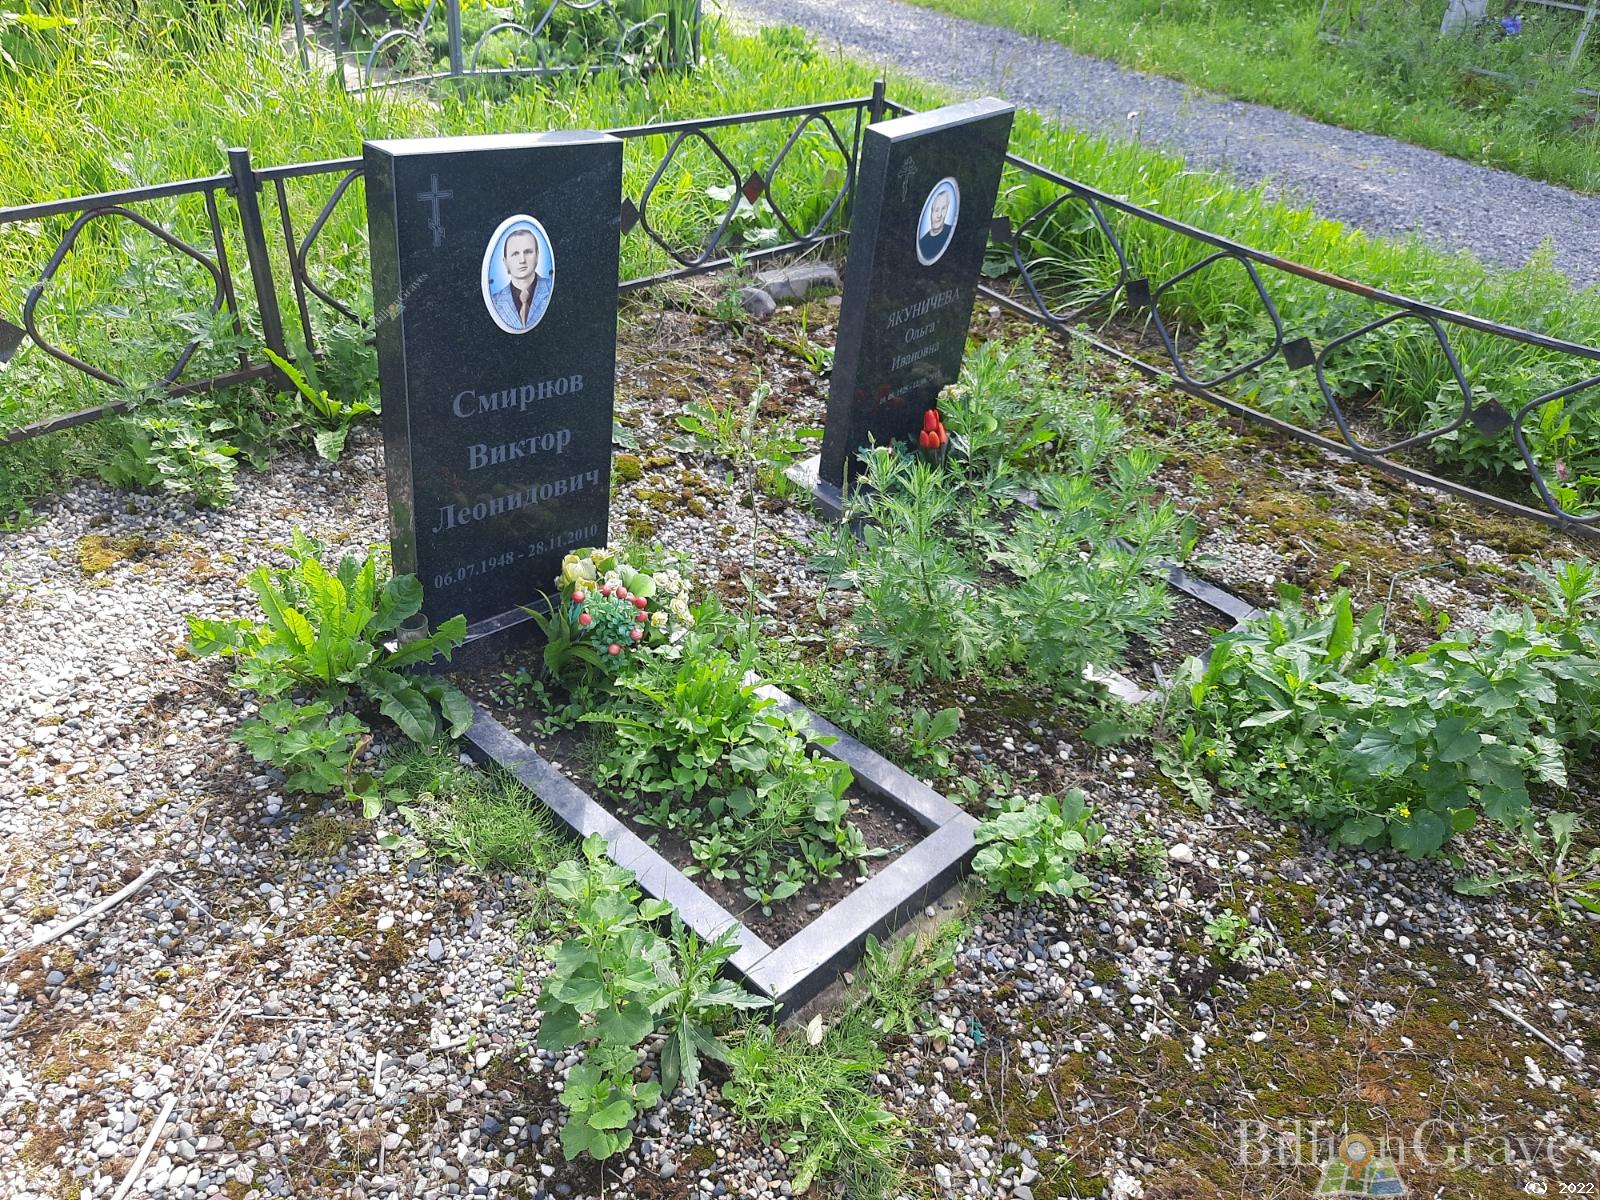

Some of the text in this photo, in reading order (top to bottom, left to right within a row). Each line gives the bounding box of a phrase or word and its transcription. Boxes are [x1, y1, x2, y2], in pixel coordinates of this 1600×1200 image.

[887, 287, 960, 330] ЯКУНИЧЕВА
[904, 321, 936, 344] Ольга
[891, 341, 941, 372] Ивановна
[452, 374, 584, 418] Смирнов
[467, 428, 571, 471] Виктор
[432, 468, 600, 534] Леонидович
[434, 551, 514, 589] 06.07.1948
[527, 523, 598, 557] 28.11.2010
